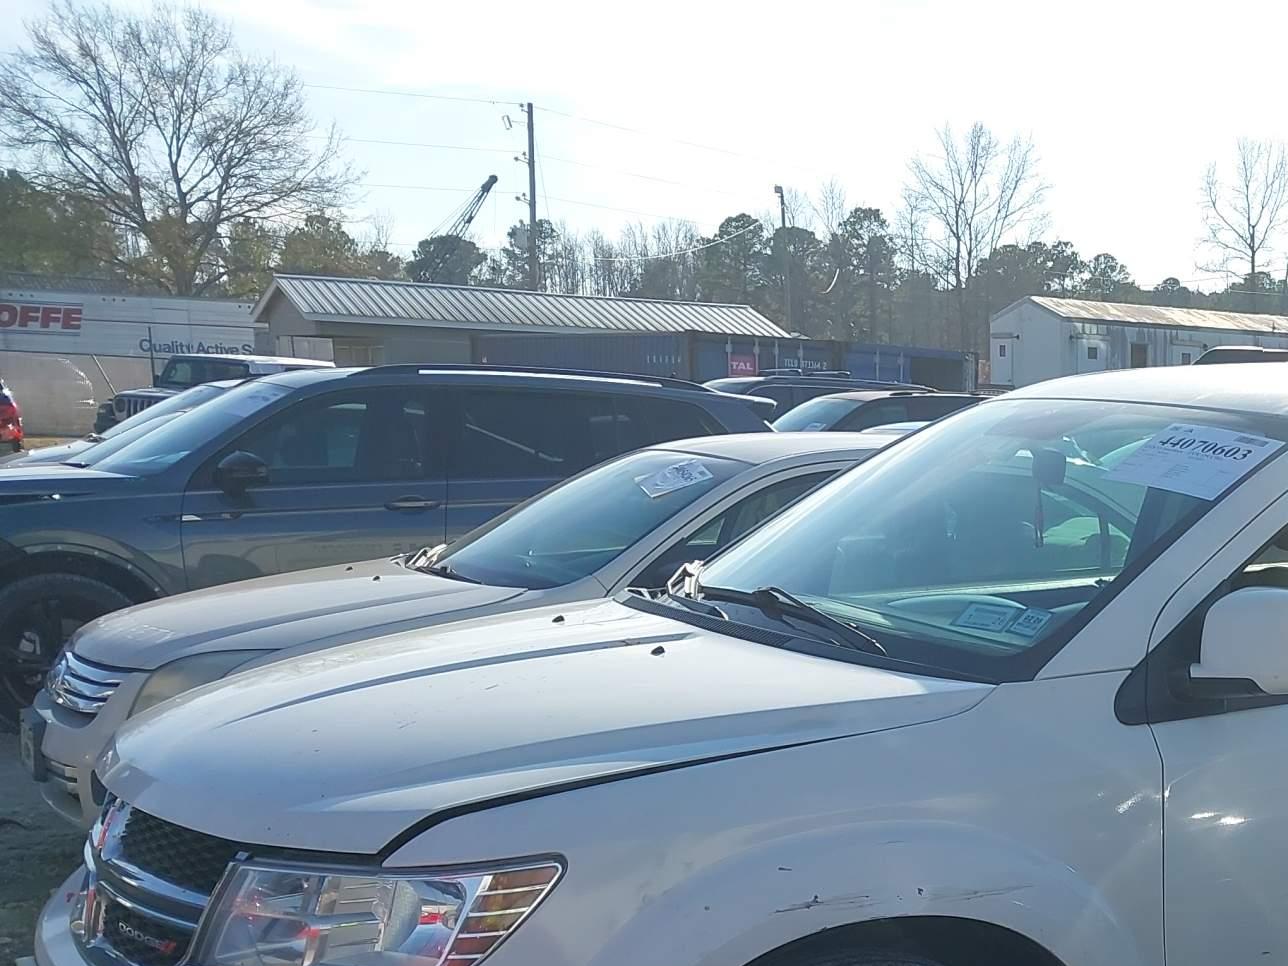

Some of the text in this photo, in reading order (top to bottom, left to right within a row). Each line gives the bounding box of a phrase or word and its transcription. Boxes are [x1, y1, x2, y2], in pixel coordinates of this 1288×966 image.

[0, 304, 82, 330] OFFE
[139, 338, 193, 354] Quality
[196, 342, 239, 355] Active
[730, 361, 753, 370] TAL
[1159, 435, 1253, 461] 44070603
